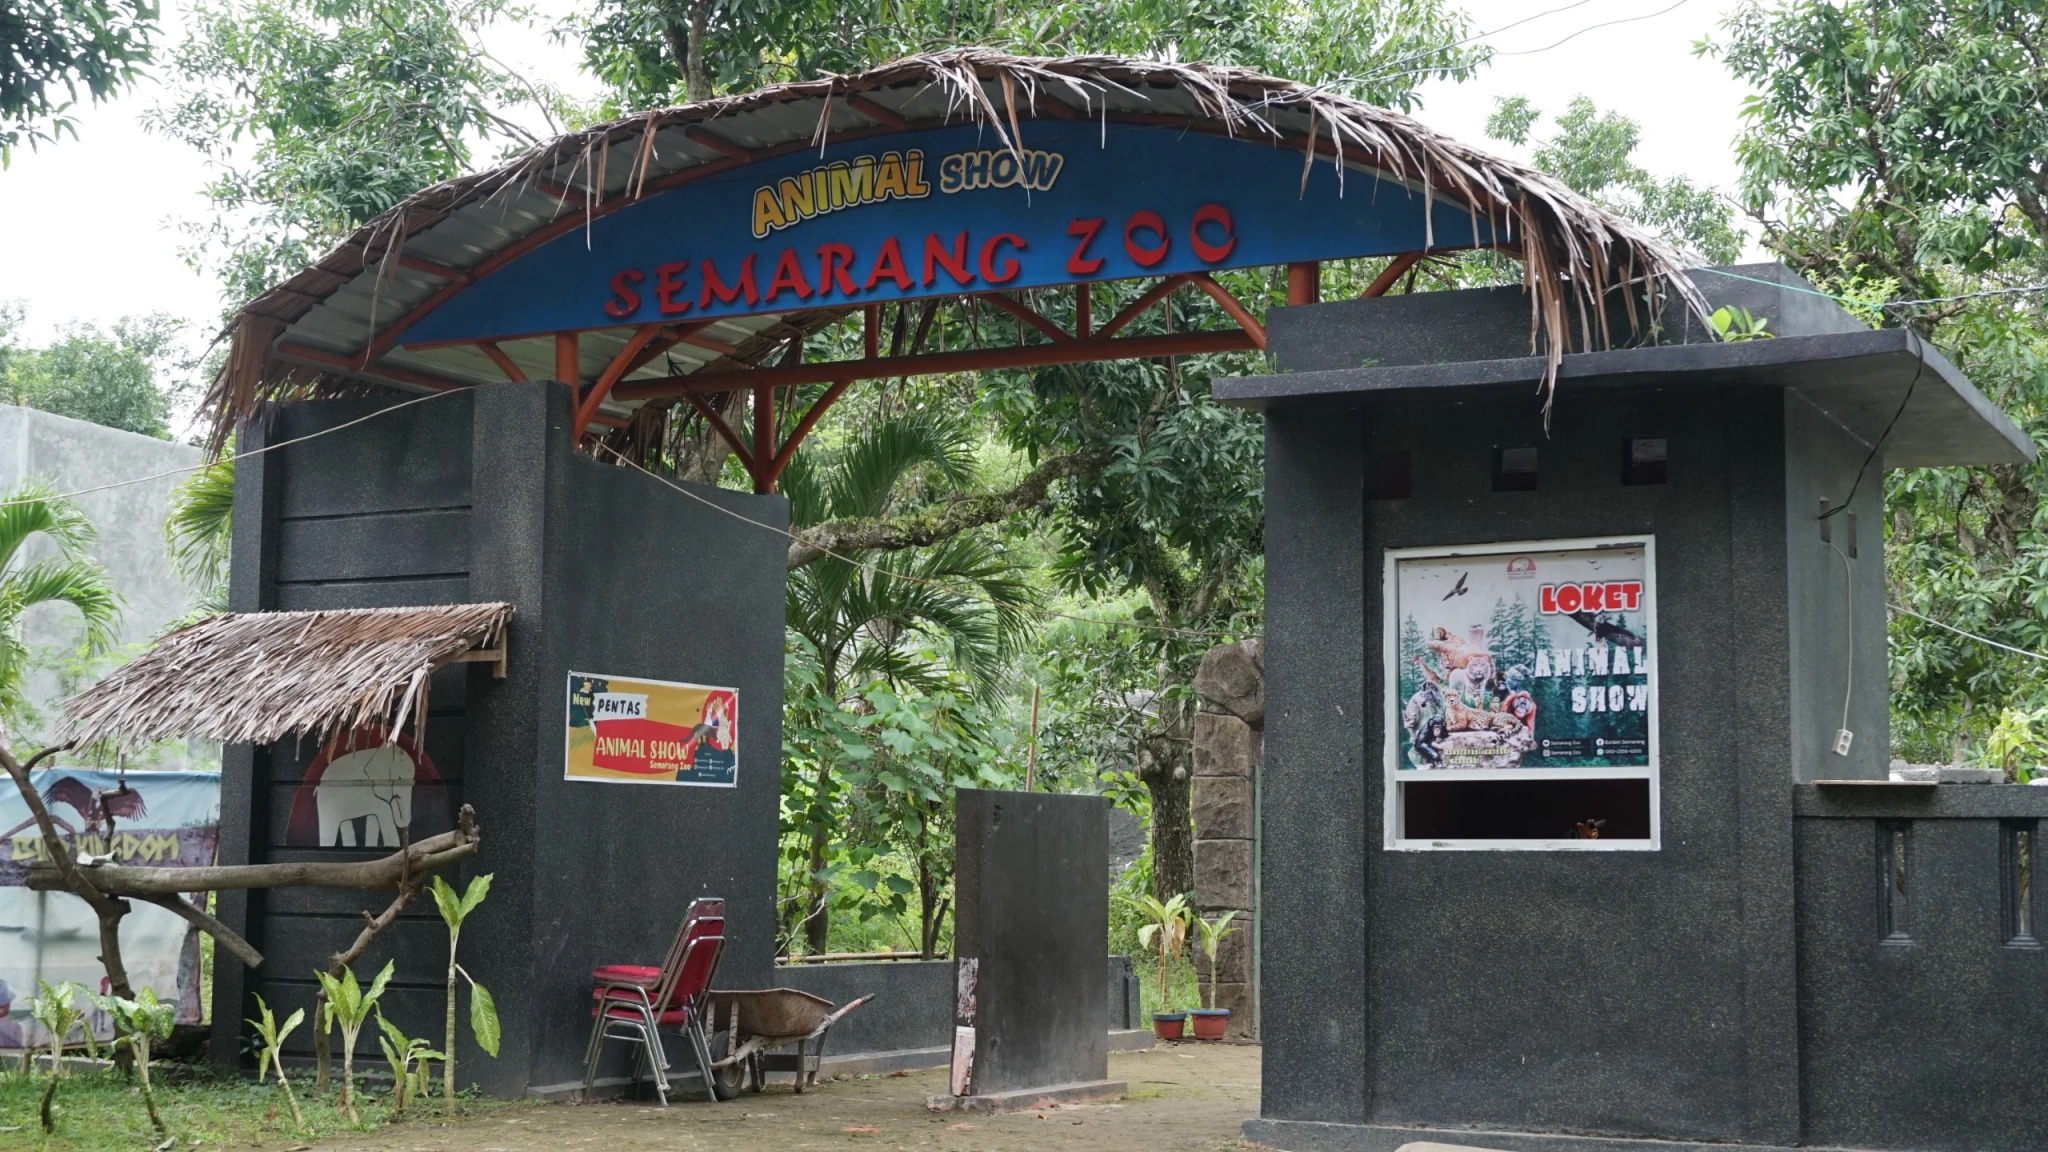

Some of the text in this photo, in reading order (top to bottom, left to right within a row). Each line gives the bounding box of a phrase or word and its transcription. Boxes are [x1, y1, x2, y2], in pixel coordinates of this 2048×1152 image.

[752, 149, 1064, 239] ANIMAL SHOW
[604, 202, 1238, 318] SEMARANG ZOO
[1540, 581, 1643, 615] LOKET
[1535, 645, 1648, 677] ANIMAL
[572, 693, 591, 707] New
[597, 698, 641, 716] PENTAS
[1571, 684, 1648, 713] SHOW
[595, 737, 690, 761] ANIMAL SHOW
[649, 761, 679, 771] Semarang
[680, 763, 692, 771] Zoo
